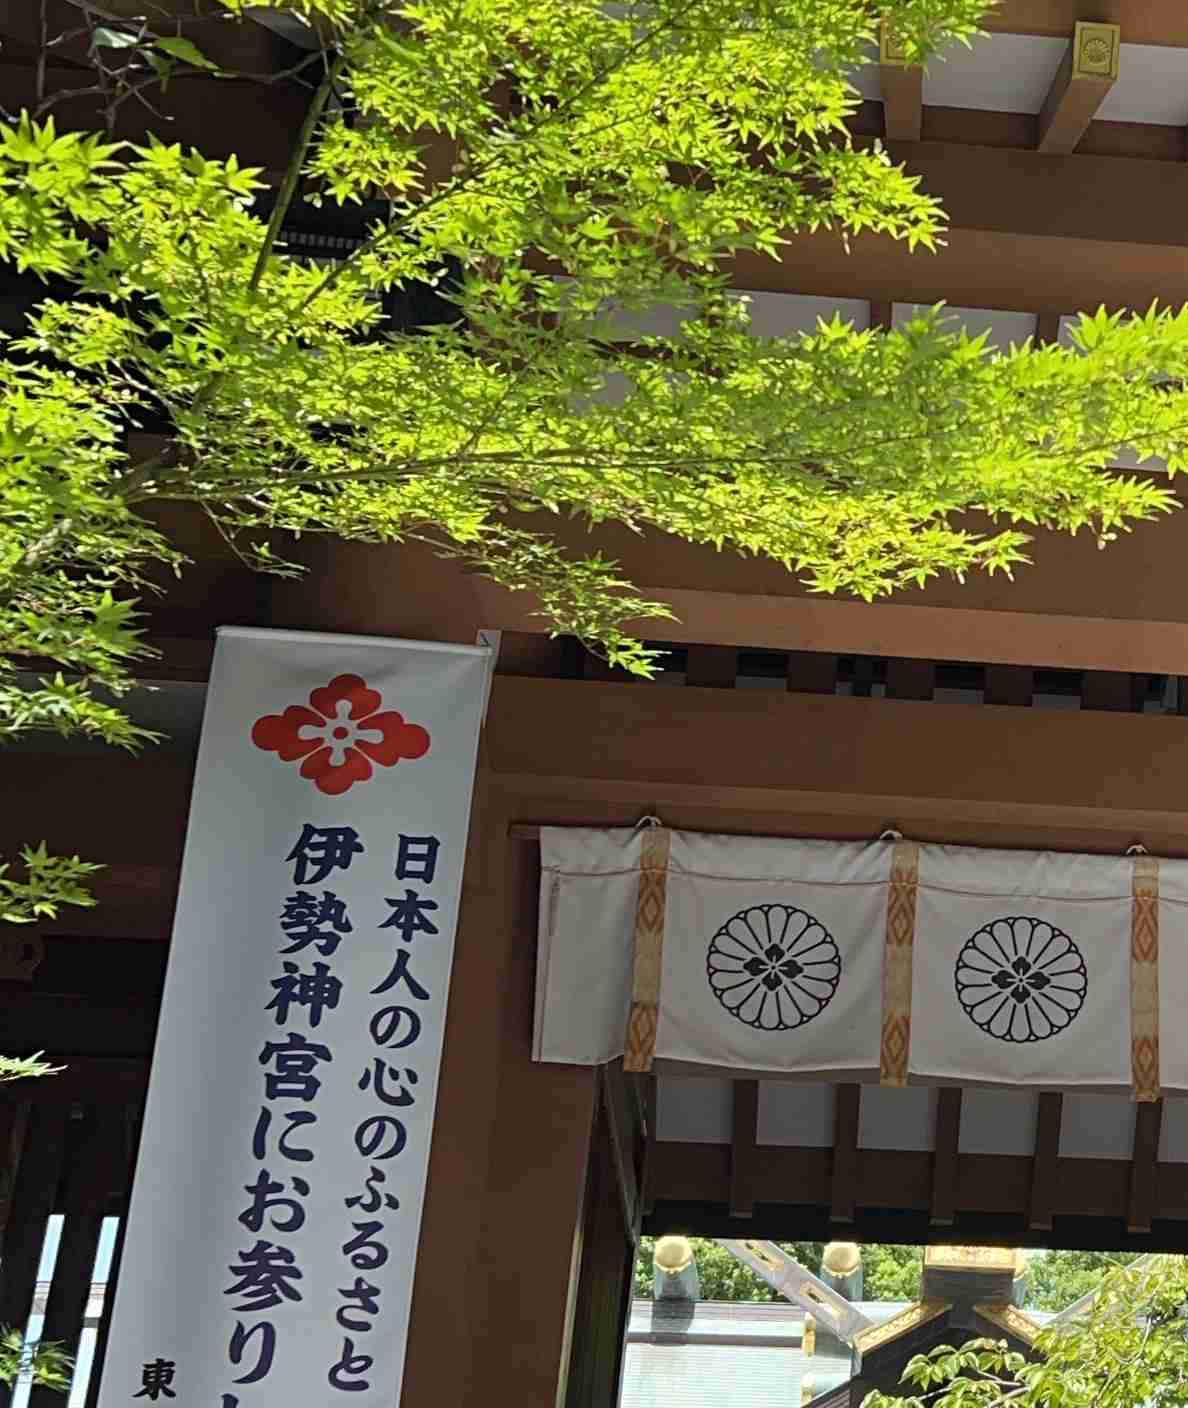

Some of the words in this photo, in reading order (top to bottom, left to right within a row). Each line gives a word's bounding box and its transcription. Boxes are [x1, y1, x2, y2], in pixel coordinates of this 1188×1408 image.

[328, 832, 441, 1392] 日本人の心のふるさと
